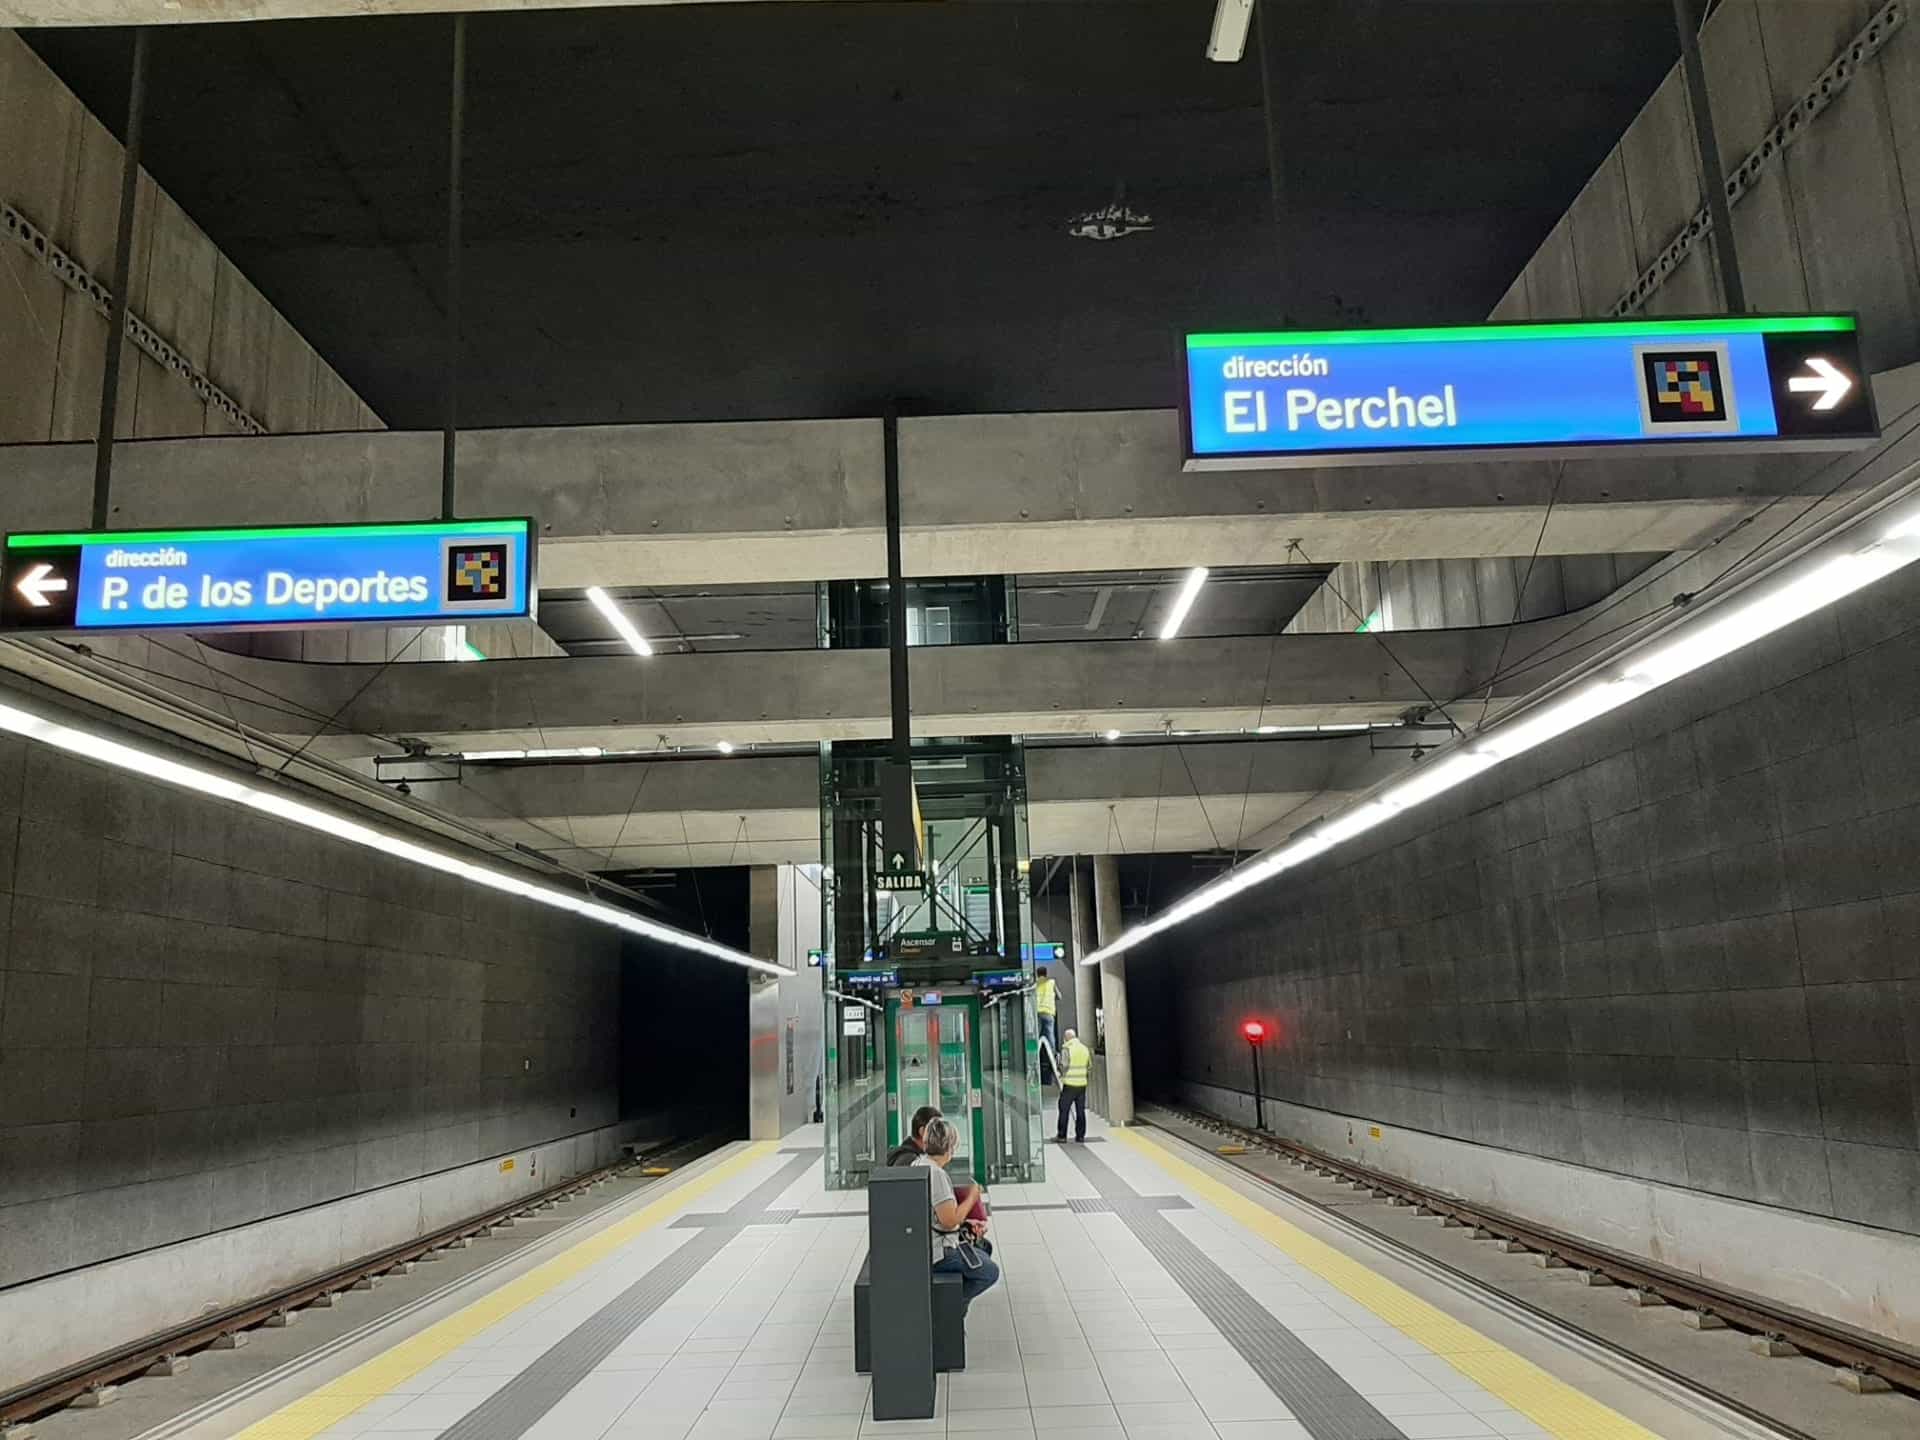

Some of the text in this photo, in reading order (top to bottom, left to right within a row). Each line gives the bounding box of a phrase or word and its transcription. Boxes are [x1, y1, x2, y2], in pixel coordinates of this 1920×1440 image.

[1223, 353, 1329, 379] dirección
[1224, 384, 1457, 433] El Perchel
[105, 547, 188, 568] dirección
[101, 570, 429, 612] P. de los Deportes
[877, 875, 922, 889] SALIDA
